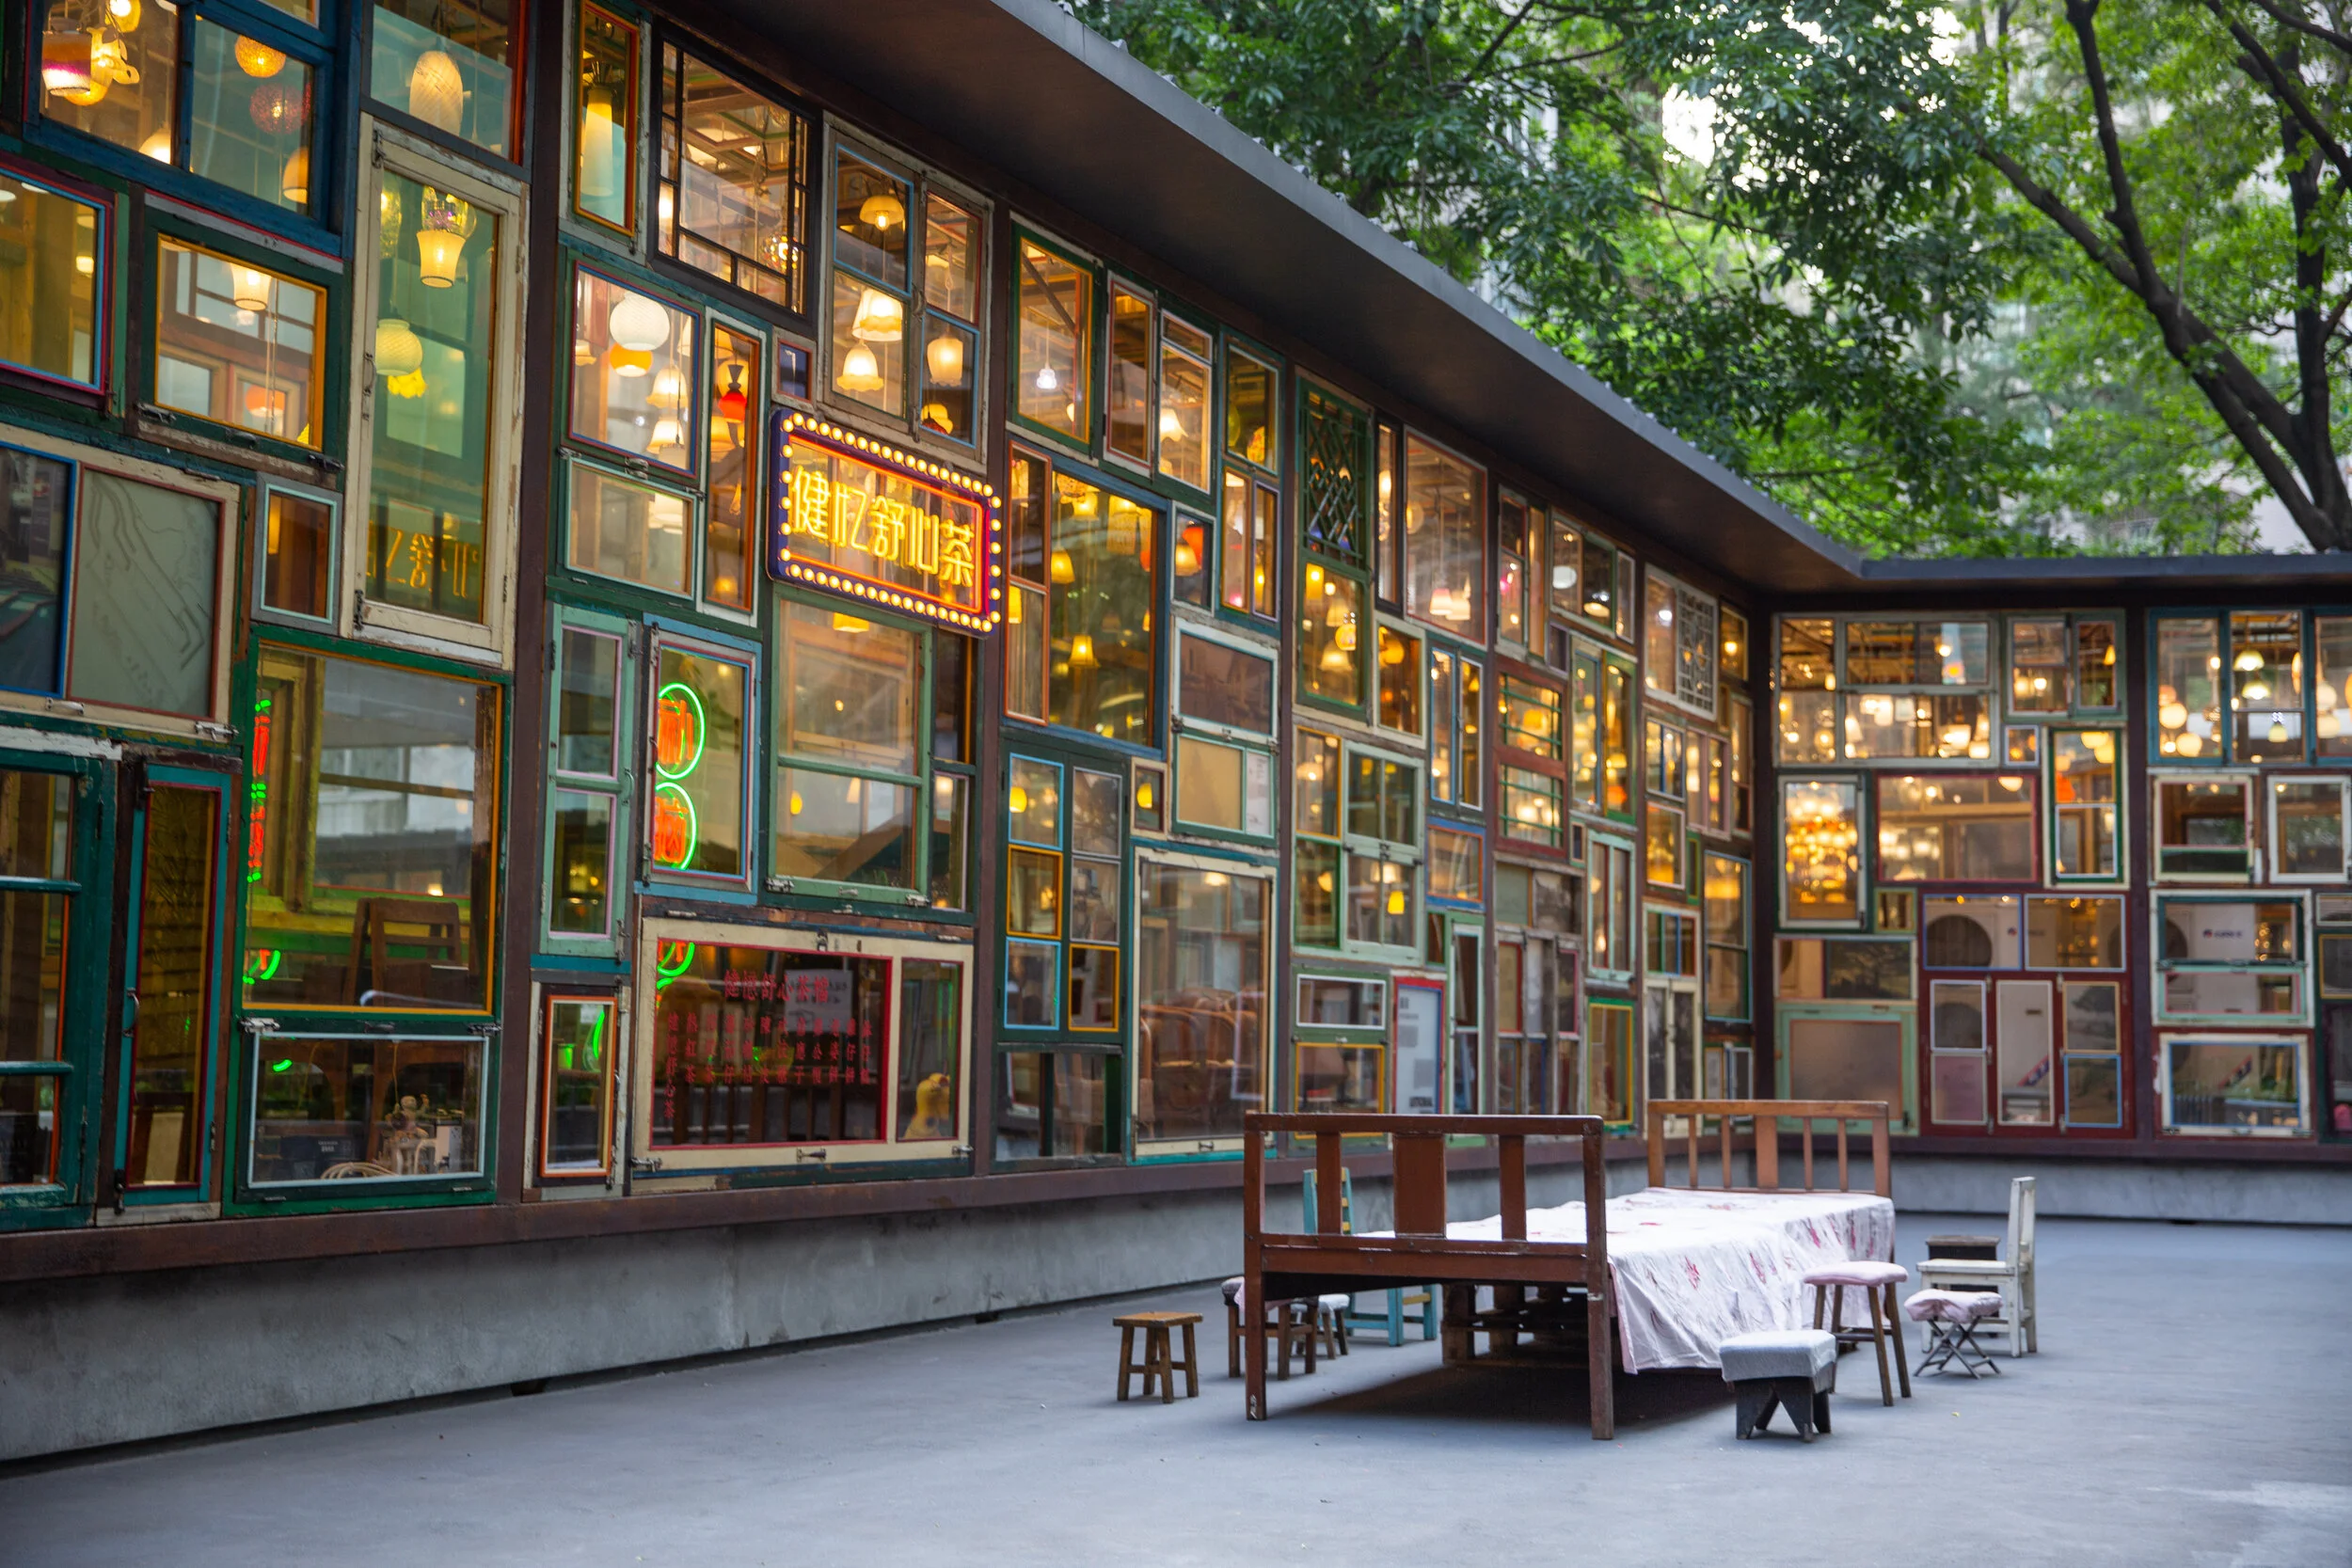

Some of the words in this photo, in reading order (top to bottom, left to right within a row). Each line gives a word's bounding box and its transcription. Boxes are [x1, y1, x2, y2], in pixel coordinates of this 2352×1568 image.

[791, 466, 975, 587] 健忆舒心茶
